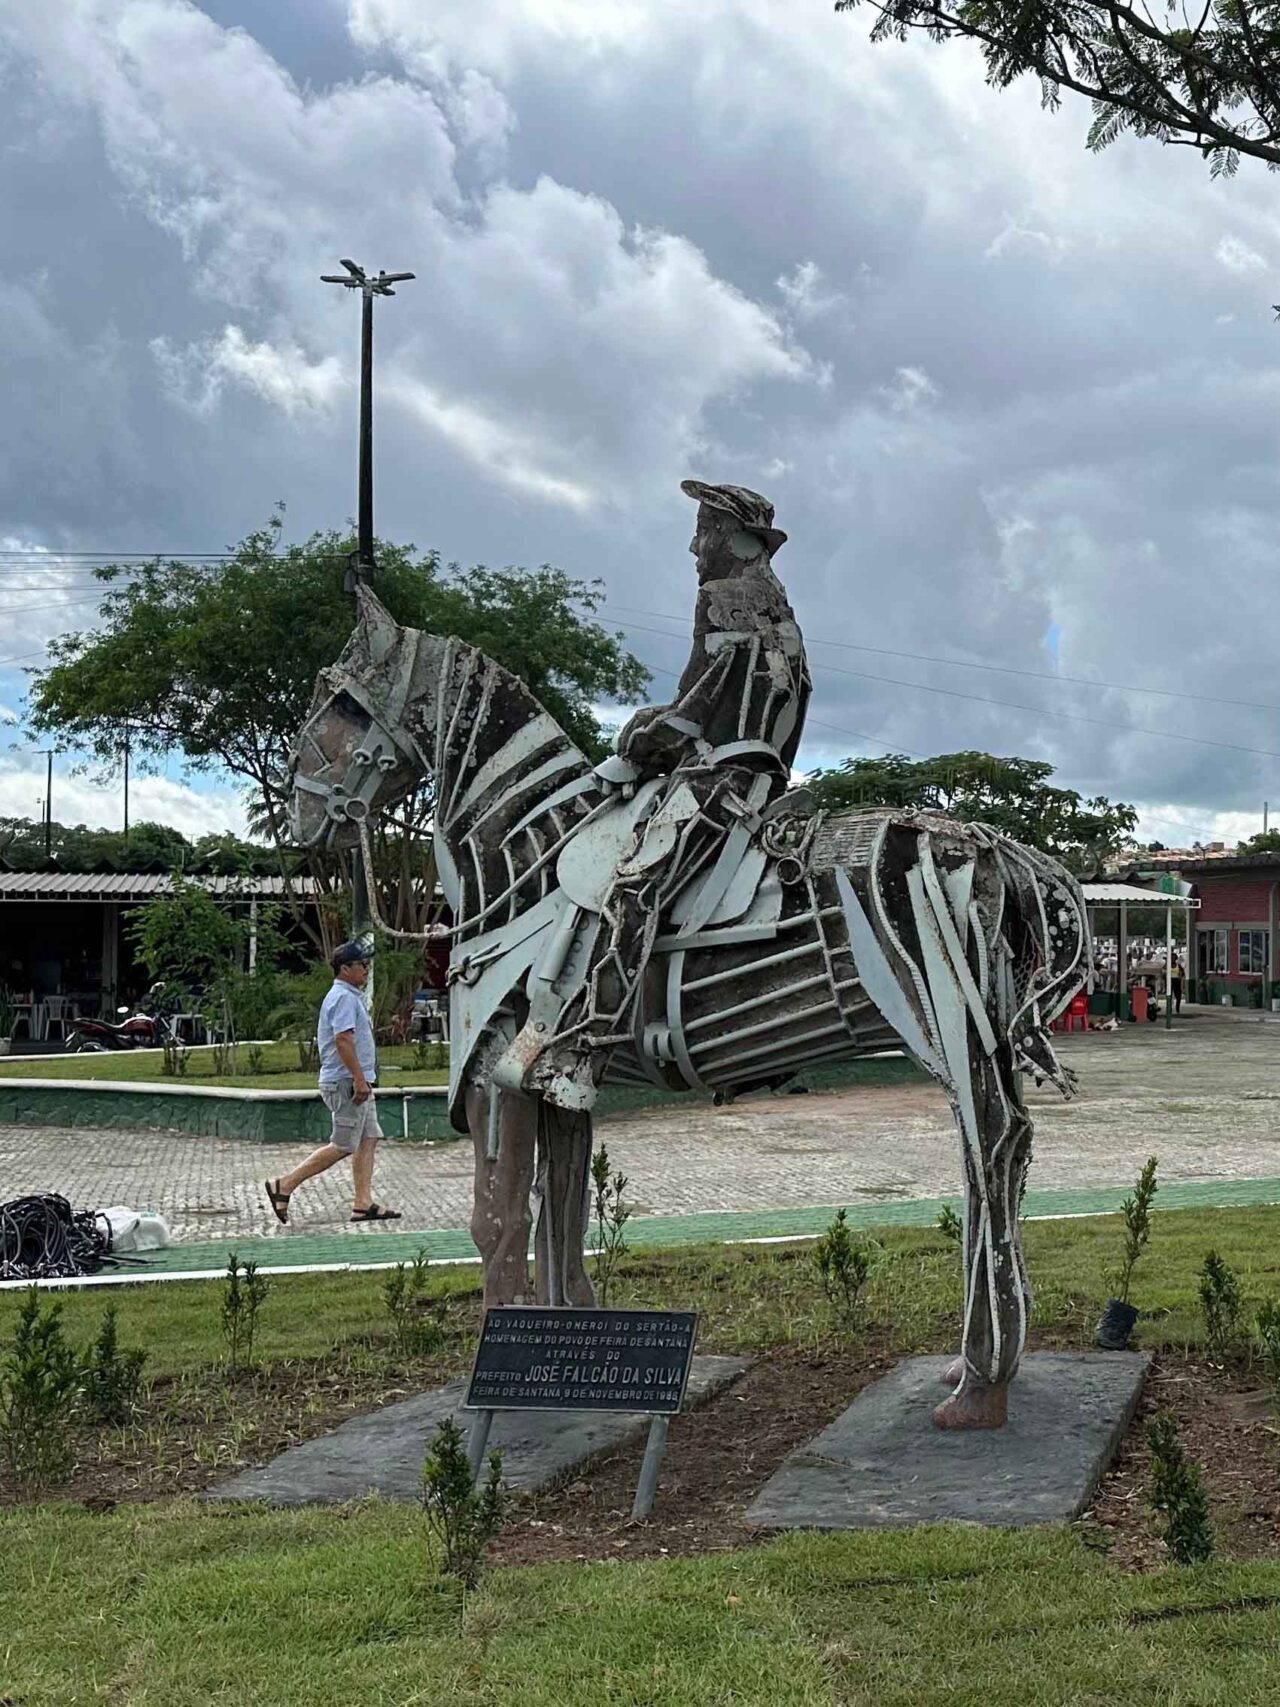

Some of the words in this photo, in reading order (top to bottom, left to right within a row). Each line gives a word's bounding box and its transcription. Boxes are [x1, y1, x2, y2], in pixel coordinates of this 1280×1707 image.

[488, 1319, 501, 1328] AO
[615, 1322, 630, 1331] DO
[484, 1334, 542, 1344] HOMENAGEM
[544, 1335, 557, 1344] DO
[558, 1335, 584, 1345] POVO
[585, 1336, 599, 1345] DE
[599, 1336, 627, 1346] FEIRA
[545, 1346, 597, 1360] ATRAVÉS
[607, 1351, 621, 1360] DO
[475, 1371, 522, 1381] PREFEITO
[525, 1360, 560, 1382] JOSÉ
[562, 1361, 619, 1383] FALCÃO
[622, 1367, 640, 1384] DA
[644, 1367, 682, 1385] SILVA
[472, 1386, 500, 1396] FEIRA
[502, 1387, 517, 1397] DE
[564, 1389, 571, 1398] 9
[572, 1389, 587, 1398] DE
[588, 1389, 642, 1400] NOVEMBRO
[643, 1390, 655, 1400] DE
